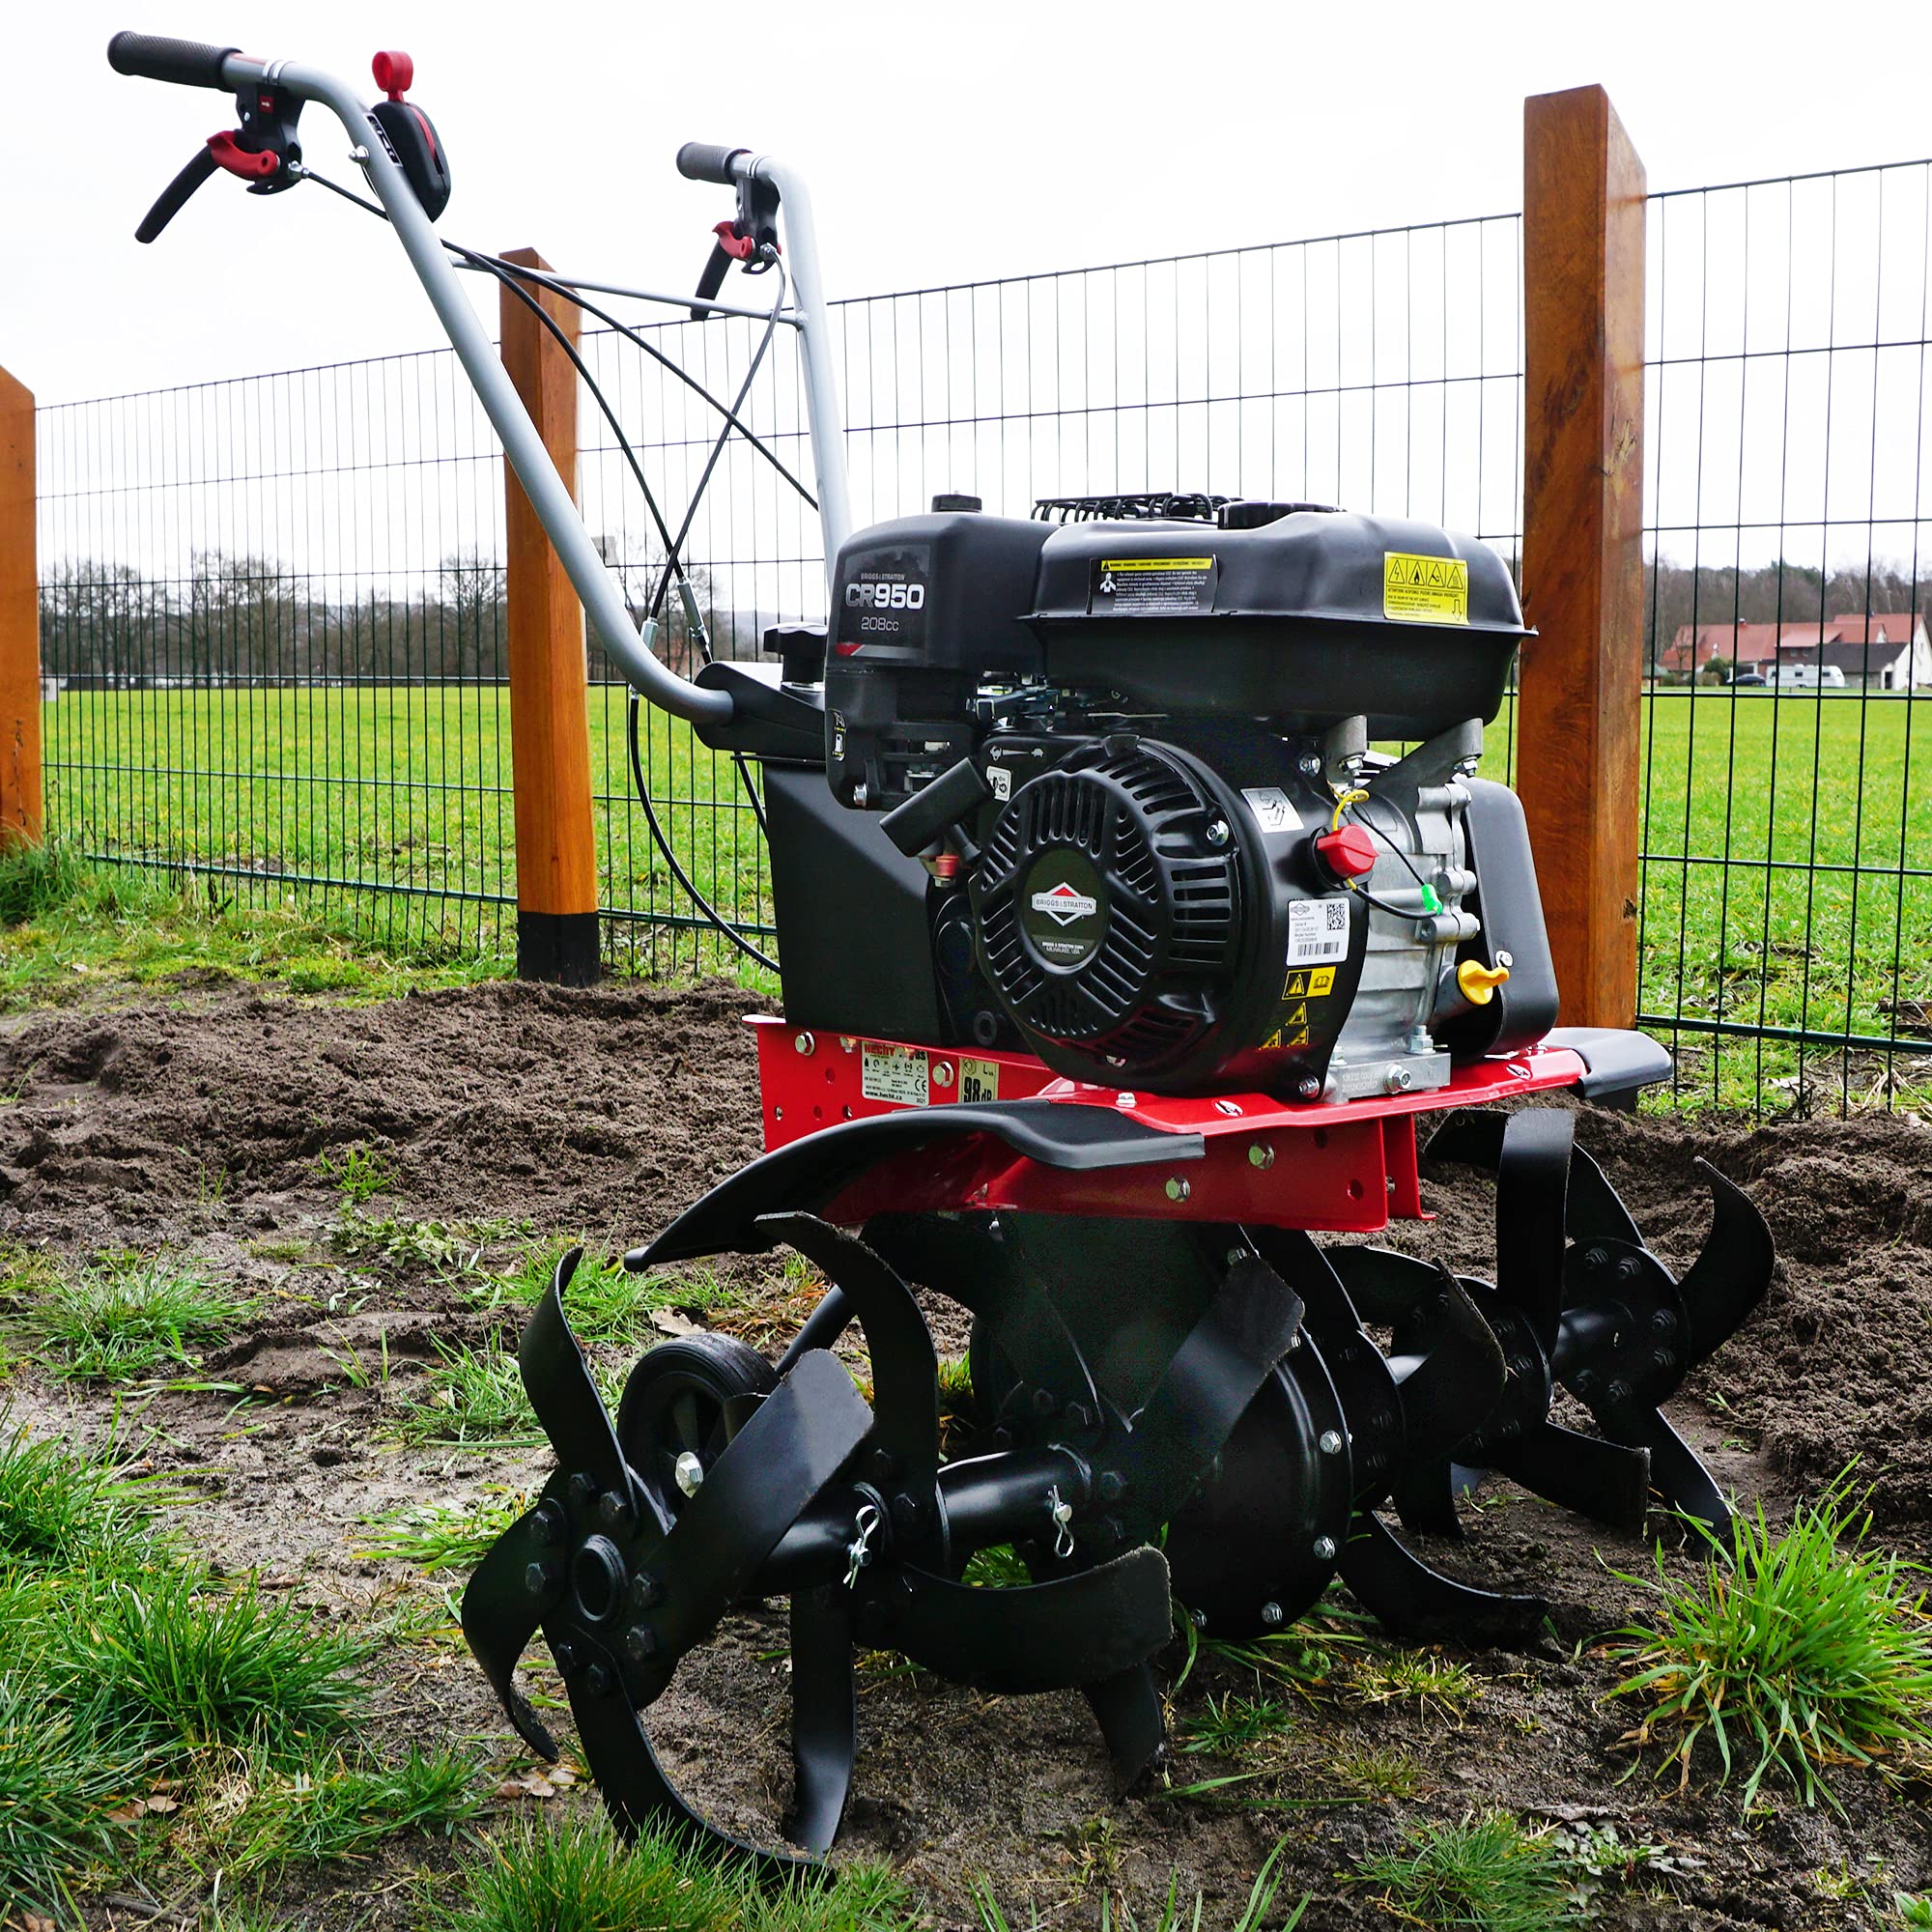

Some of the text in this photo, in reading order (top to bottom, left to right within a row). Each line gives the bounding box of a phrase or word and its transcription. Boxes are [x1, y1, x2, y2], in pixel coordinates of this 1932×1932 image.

[845, 582, 925, 610] CR950
[861, 616, 899, 631] 208cc
[963, 1076, 980, 1102] 98
